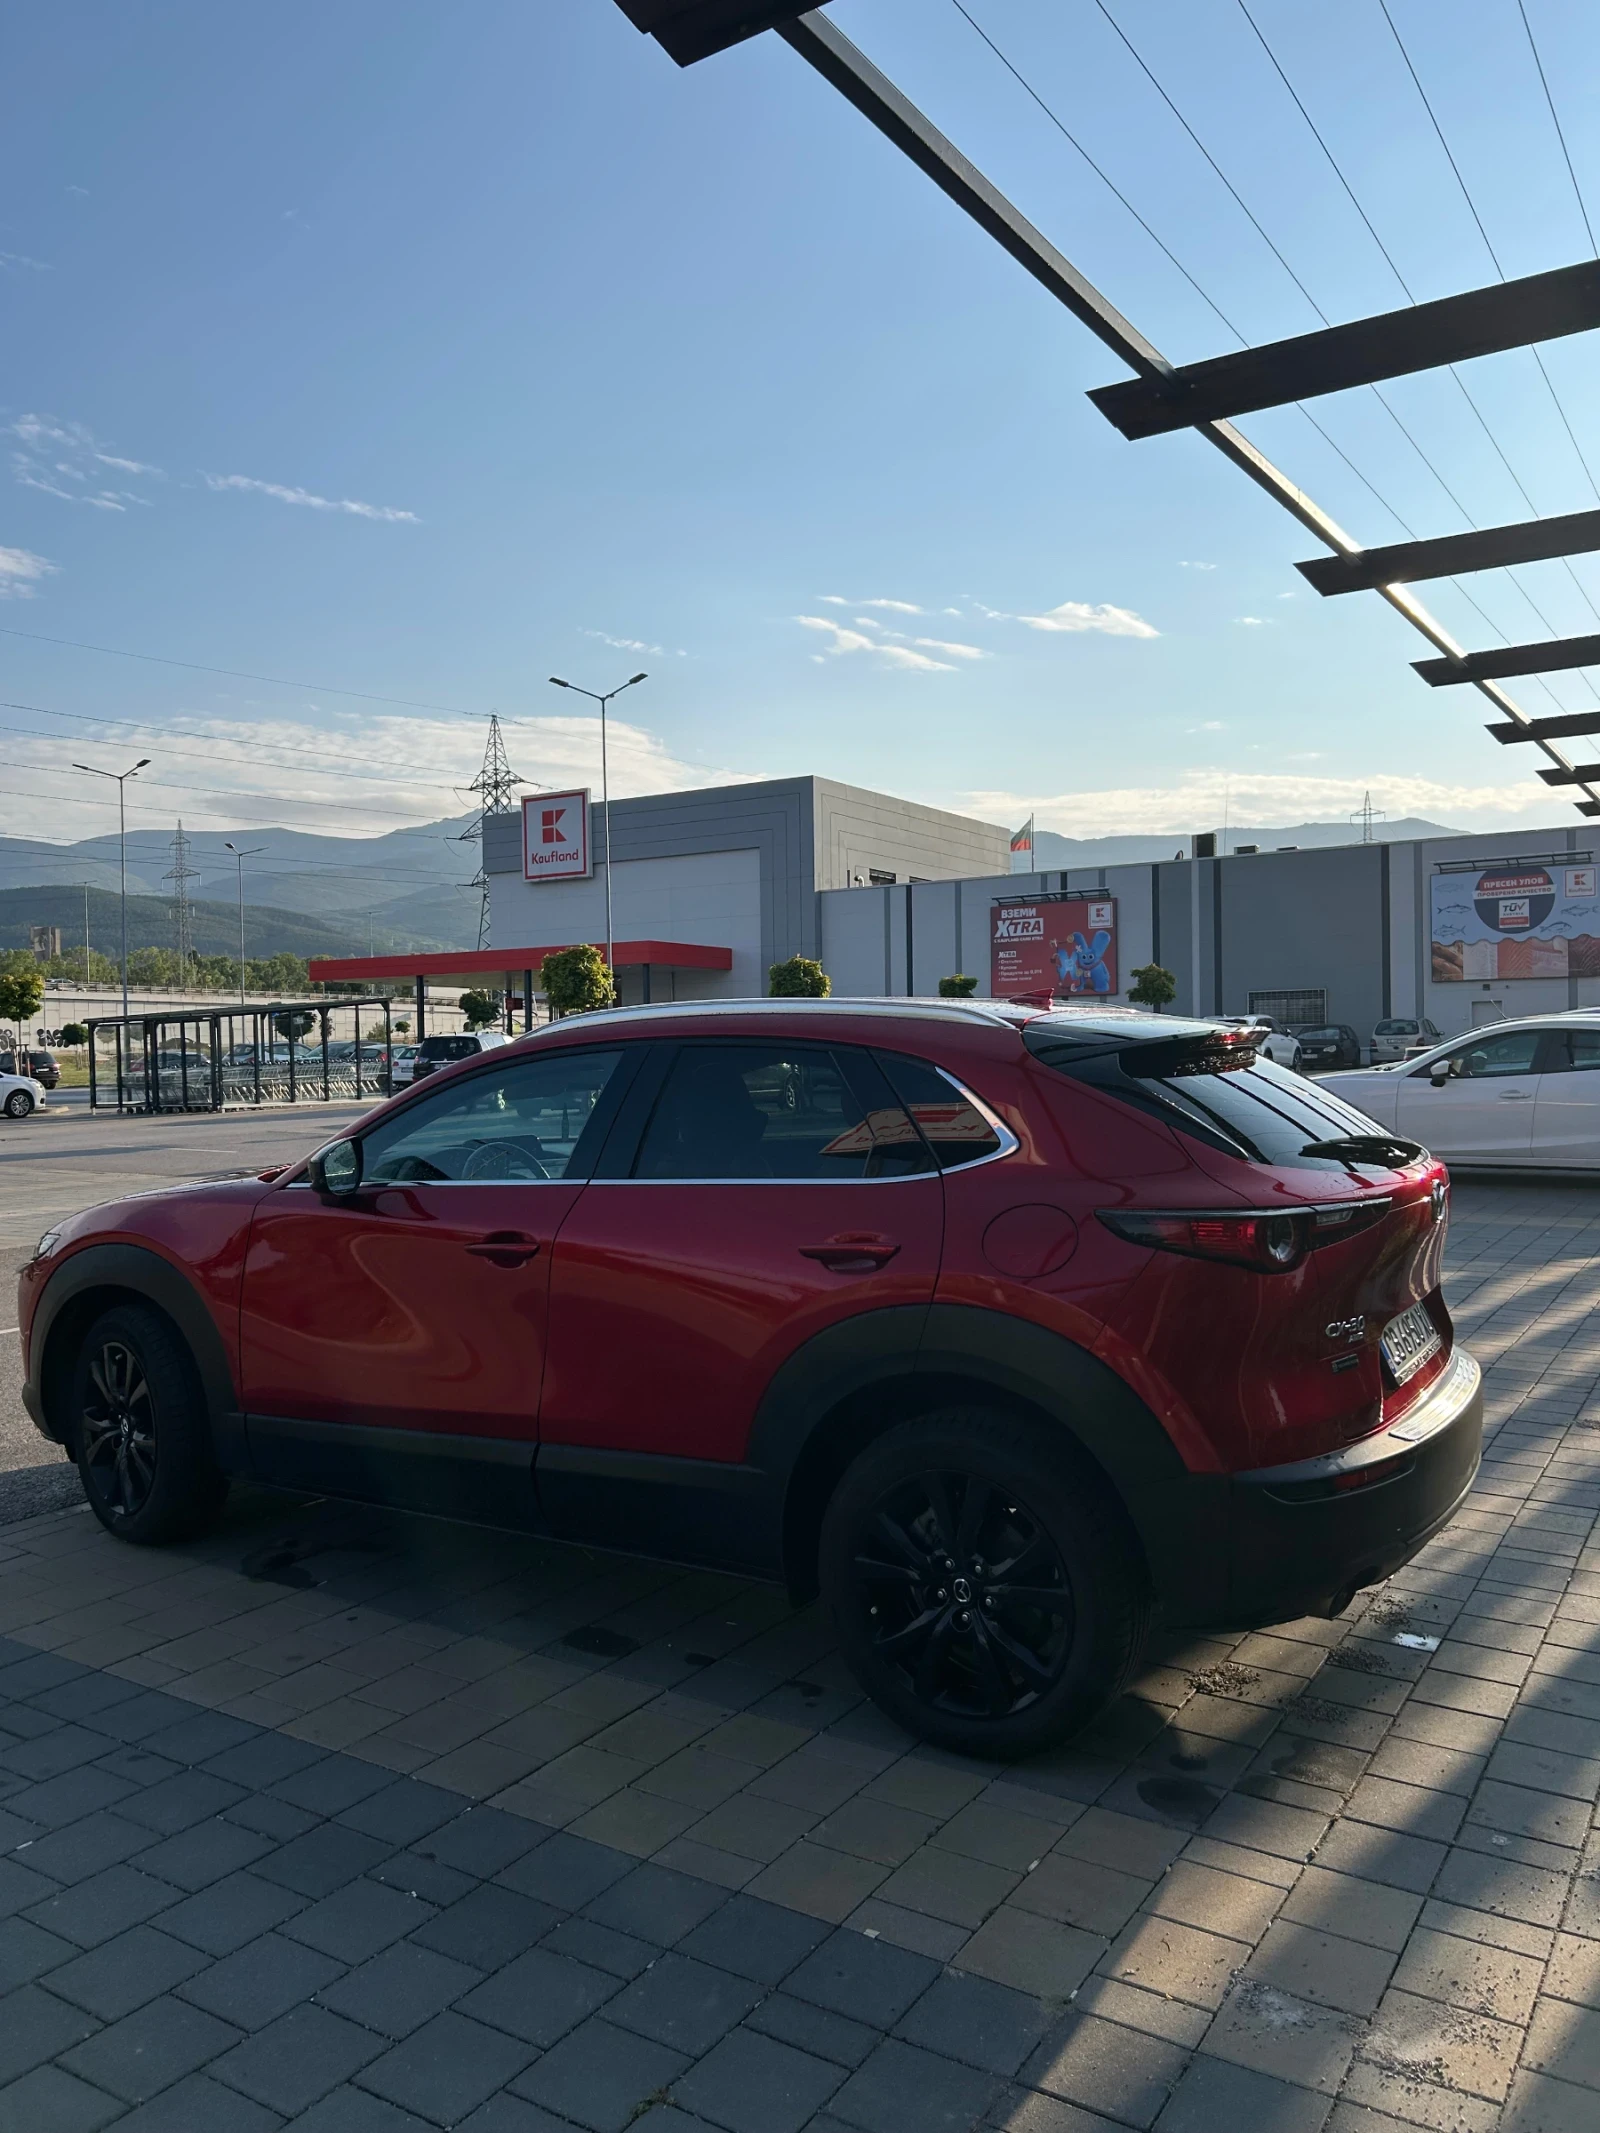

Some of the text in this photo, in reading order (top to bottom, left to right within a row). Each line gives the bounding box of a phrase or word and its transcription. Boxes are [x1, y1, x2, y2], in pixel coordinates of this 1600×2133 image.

[542, 808, 567, 844] K
[531, 849, 579, 865] Kaufland
[1484, 878, 1543, 889] ПРЕСЕН УЛОВ
[1477, 887, 1552, 897] ПРОВЕРЕНО КАЧЕСТВО
[1001, 908, 1036, 918] ВЗЕМИ
[1502, 902, 1525, 912] TÜV
[994, 918, 1044, 937] XTRA
[1325, 1315, 1365, 1337] CX-30
